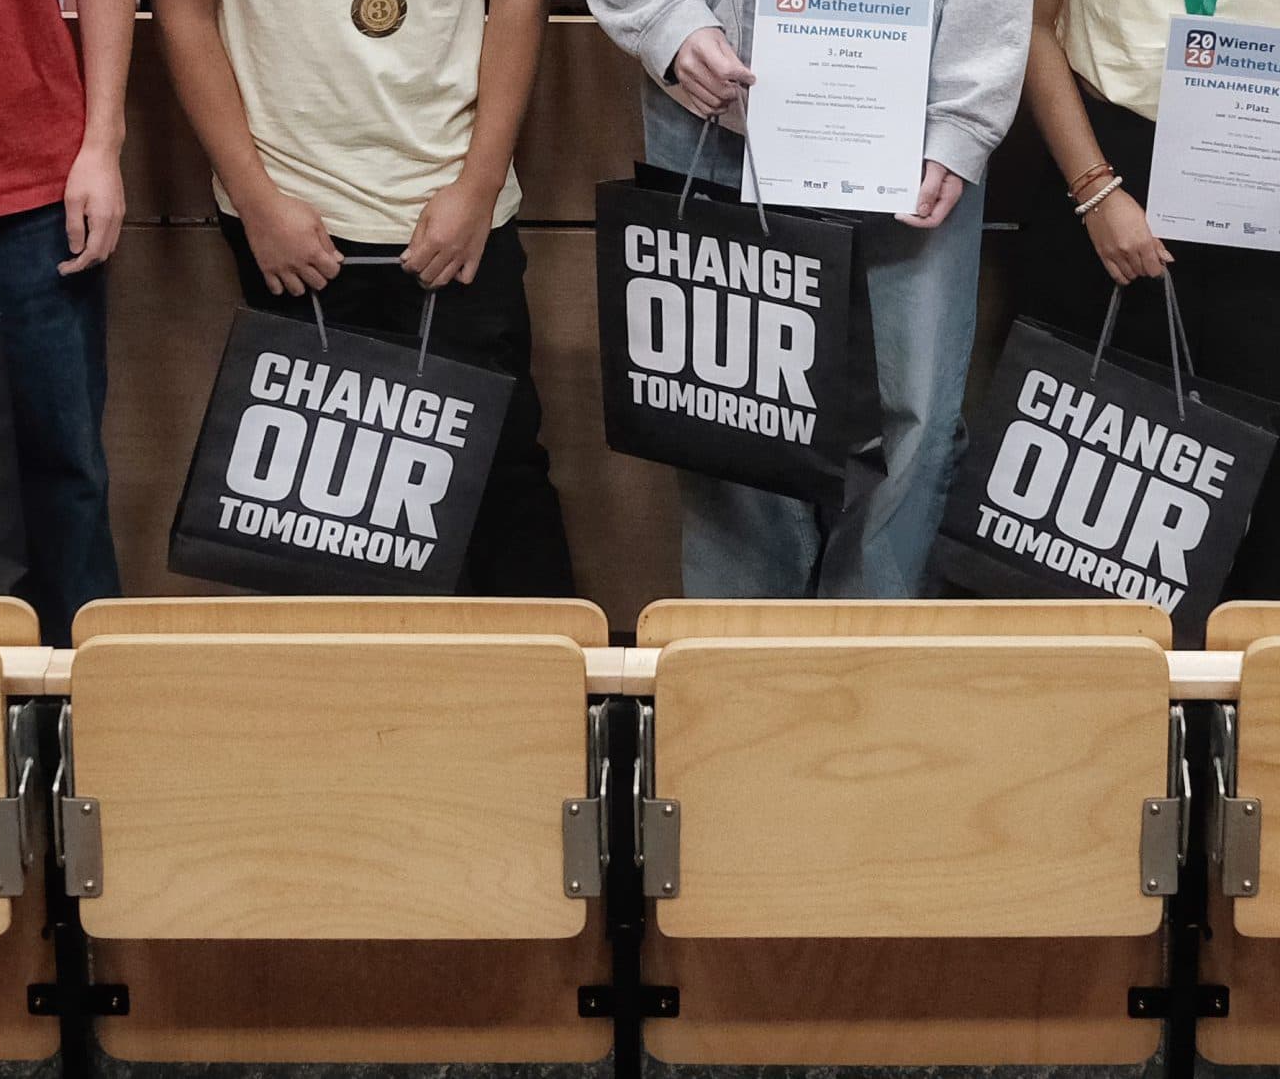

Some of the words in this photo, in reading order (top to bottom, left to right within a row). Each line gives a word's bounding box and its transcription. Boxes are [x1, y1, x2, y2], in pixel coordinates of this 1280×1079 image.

[372, 0, 392, 20] 3
[777, 24, 907, 41] TEILNAHMEURKUNDE
[1187, 32, 1214, 49] 20
[1219, 36, 1276, 53] Wiener
[839, 49, 863, 58] Platz
[1186, 49, 1212, 65] 26
[1246, 103, 1270, 113] Platz
[625, 224, 821, 308] CHANGE
[626, 277, 817, 409] OUR
[250, 352, 474, 448] CHANGE
[628, 371, 817, 445] TOMORROW
[1017, 370, 1235, 499] CHANGE
[225, 404, 454, 539] OUR
[986, 420, 1210, 587] OUR
[219, 496, 435, 572] TOMORROW
[976, 504, 1185, 616] TOMORROW
